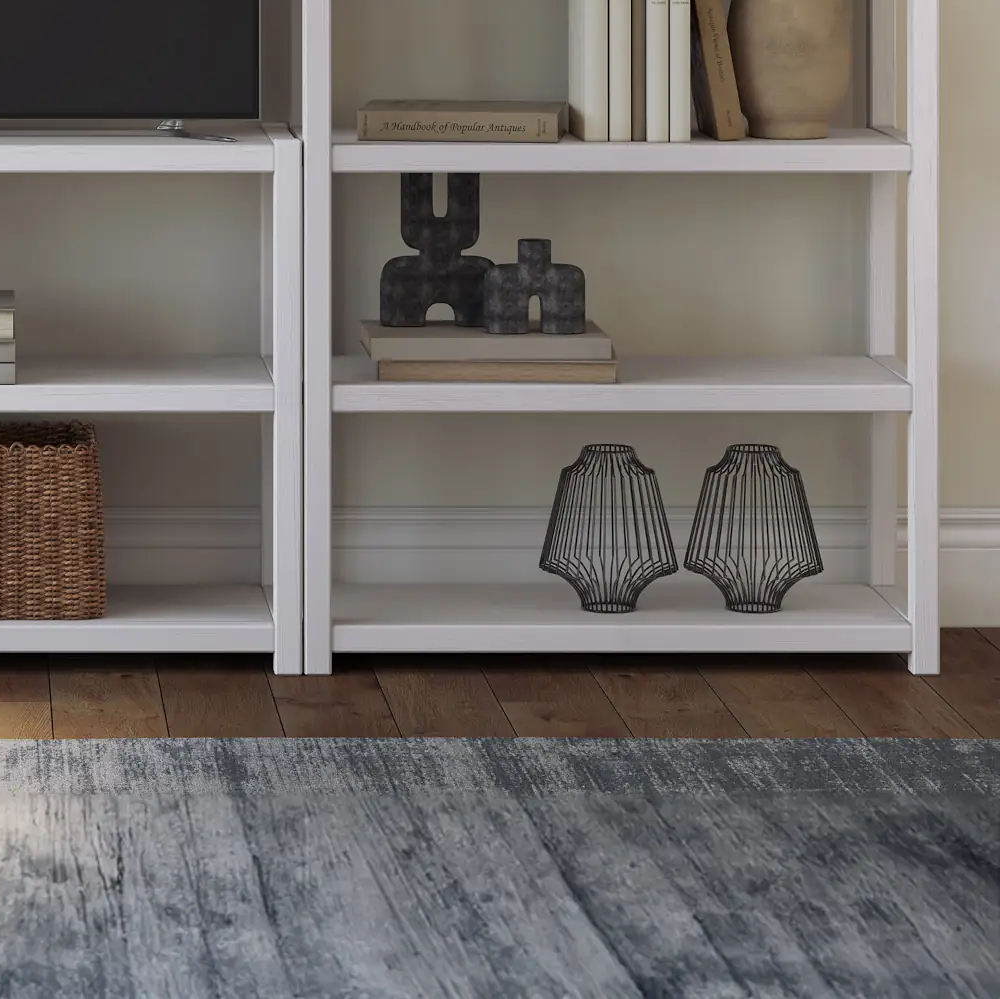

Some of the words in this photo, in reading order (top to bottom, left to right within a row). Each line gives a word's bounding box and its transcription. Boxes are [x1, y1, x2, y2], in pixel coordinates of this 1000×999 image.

[380, 122, 390, 132] A
[390, 121, 438, 132] Handbook
[438, 122, 449, 134] of
[449, 122, 486, 134] Popular
[485, 122, 527, 134] Antiques
